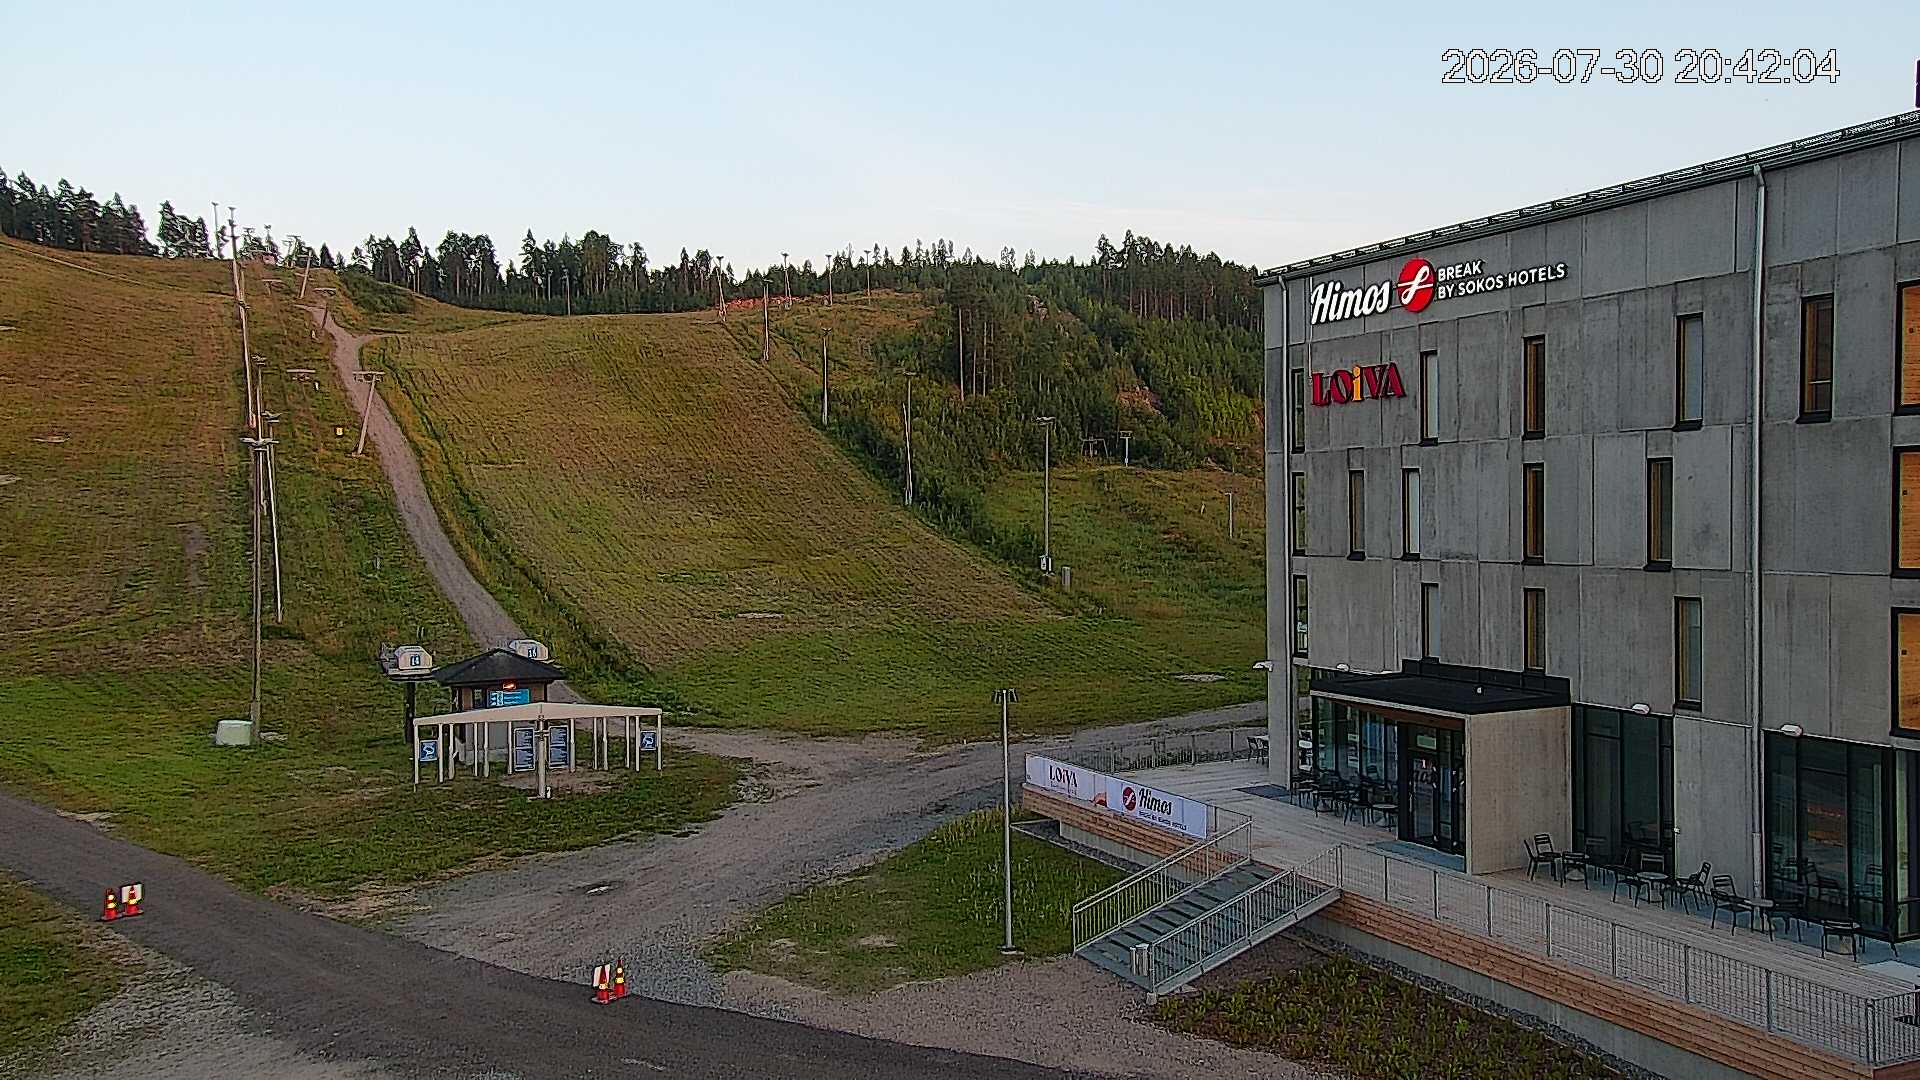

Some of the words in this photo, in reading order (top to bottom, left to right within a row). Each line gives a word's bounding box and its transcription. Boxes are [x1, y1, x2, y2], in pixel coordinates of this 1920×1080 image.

[1437, 260, 1482, 281] BREAK
[1437, 286, 1455, 299] BY
[1458, 276, 1504, 295] SOKOS
[1508, 263, 1566, 287] HOTELS
[1310, 281, 1390, 324] Himos
[1139, 788, 1172, 815] Himos
